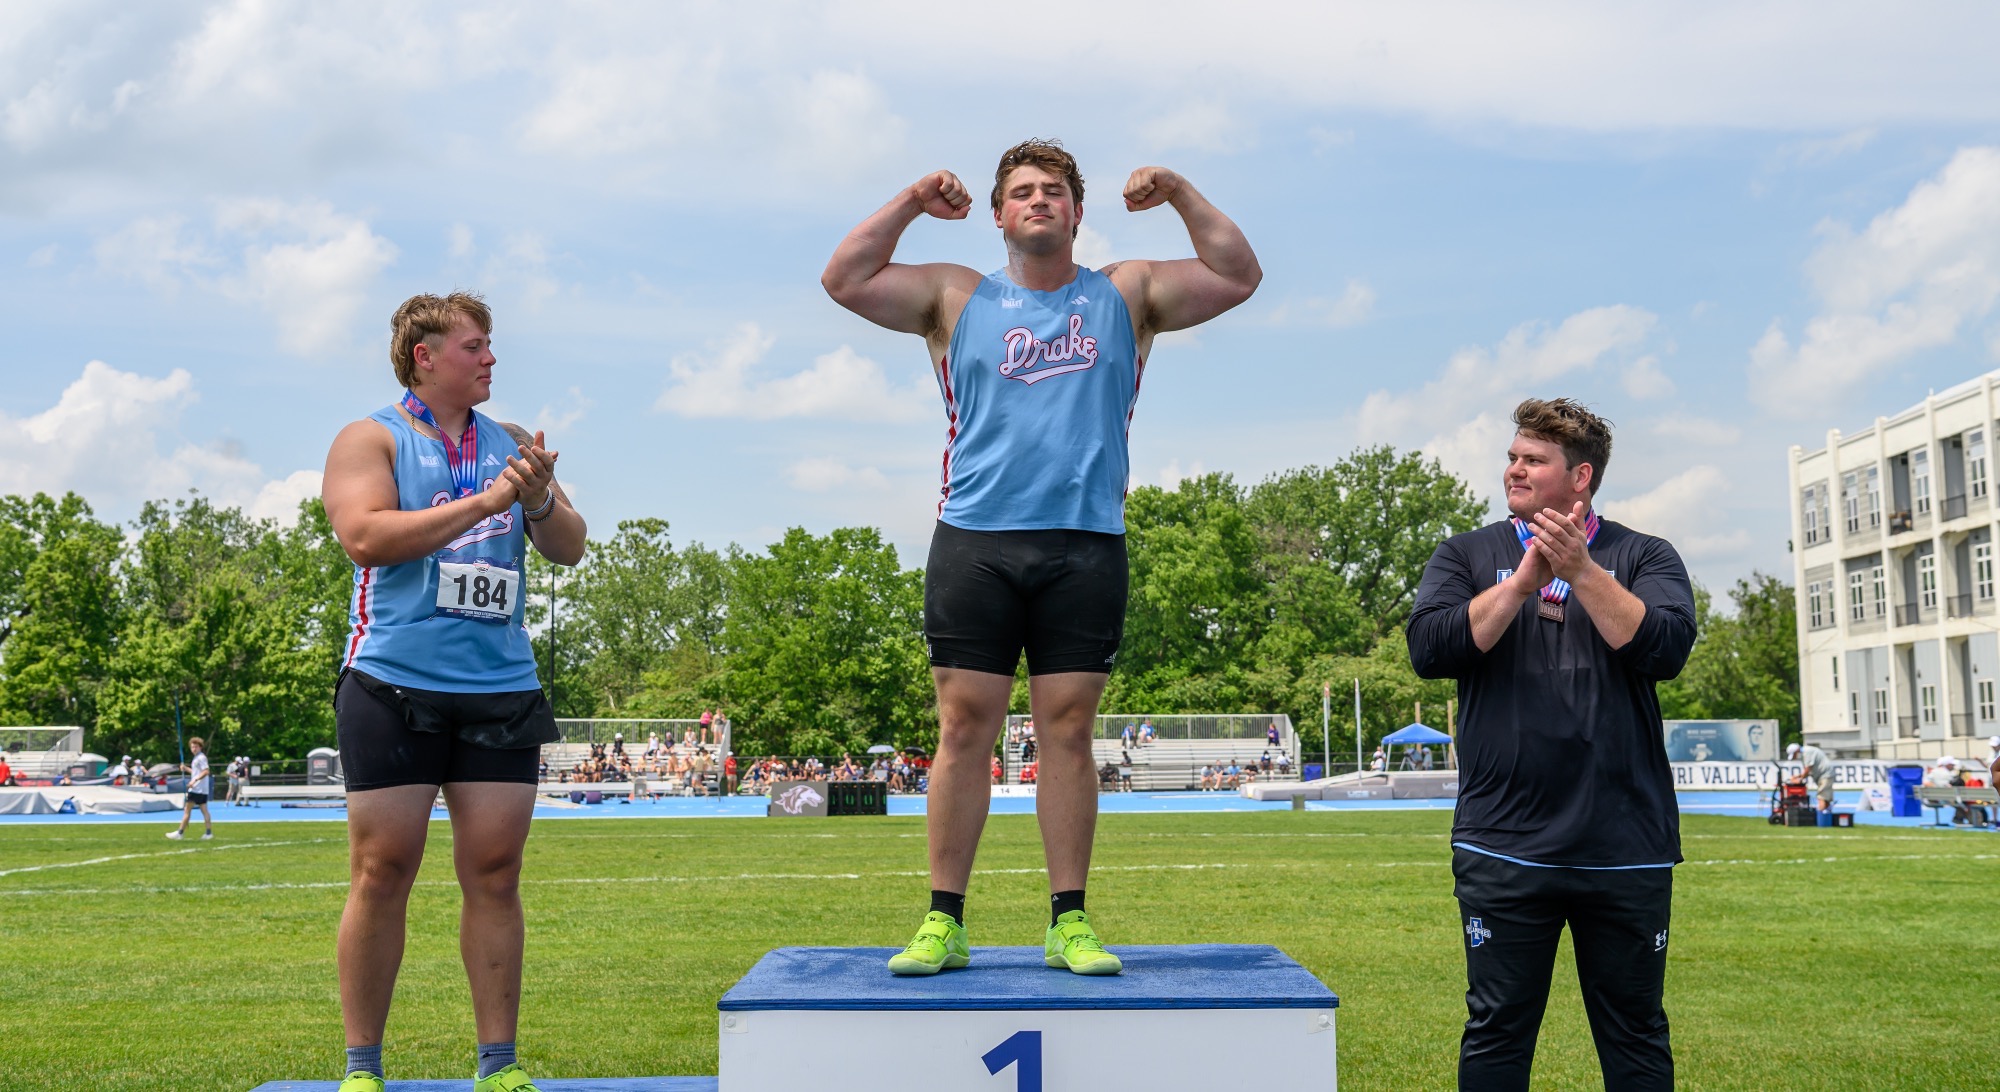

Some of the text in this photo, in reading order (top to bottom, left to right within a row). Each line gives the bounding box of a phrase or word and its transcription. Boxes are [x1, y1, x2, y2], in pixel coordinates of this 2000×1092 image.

[999, 314, 1098, 377] Drake
[454, 574, 507, 610] 184
[1702, 767, 1769, 784] VALLEY
[981, 1031, 1042, 1092] 1
